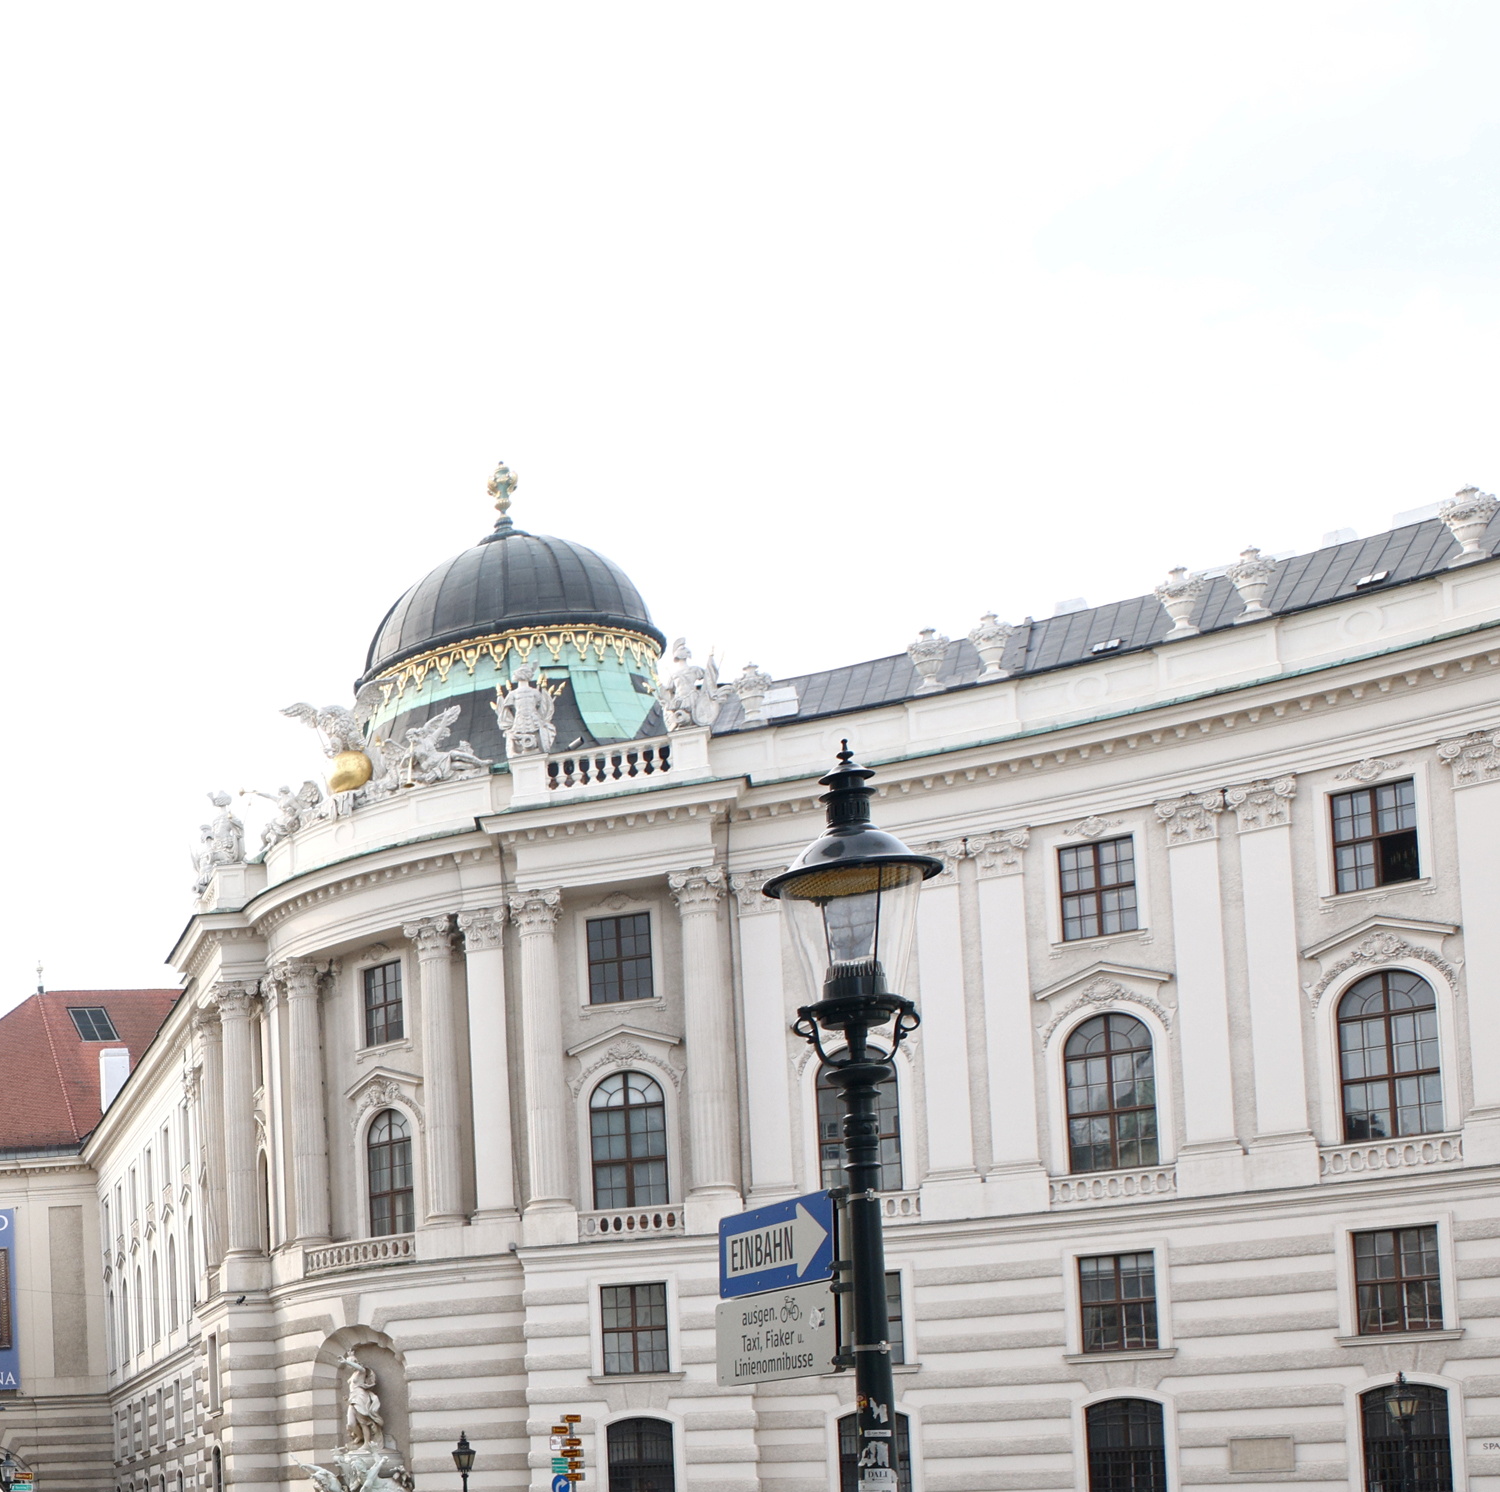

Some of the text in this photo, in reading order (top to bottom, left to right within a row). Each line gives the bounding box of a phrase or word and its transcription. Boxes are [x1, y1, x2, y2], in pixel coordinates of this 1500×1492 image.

[731, 1225, 794, 1272] EINBAHN
[742, 1307, 778, 1328] ausgen.
[741, 1329, 805, 1354] Taxi, Fiaker u.
[735, 1352, 814, 1378] Linienomnibusse
